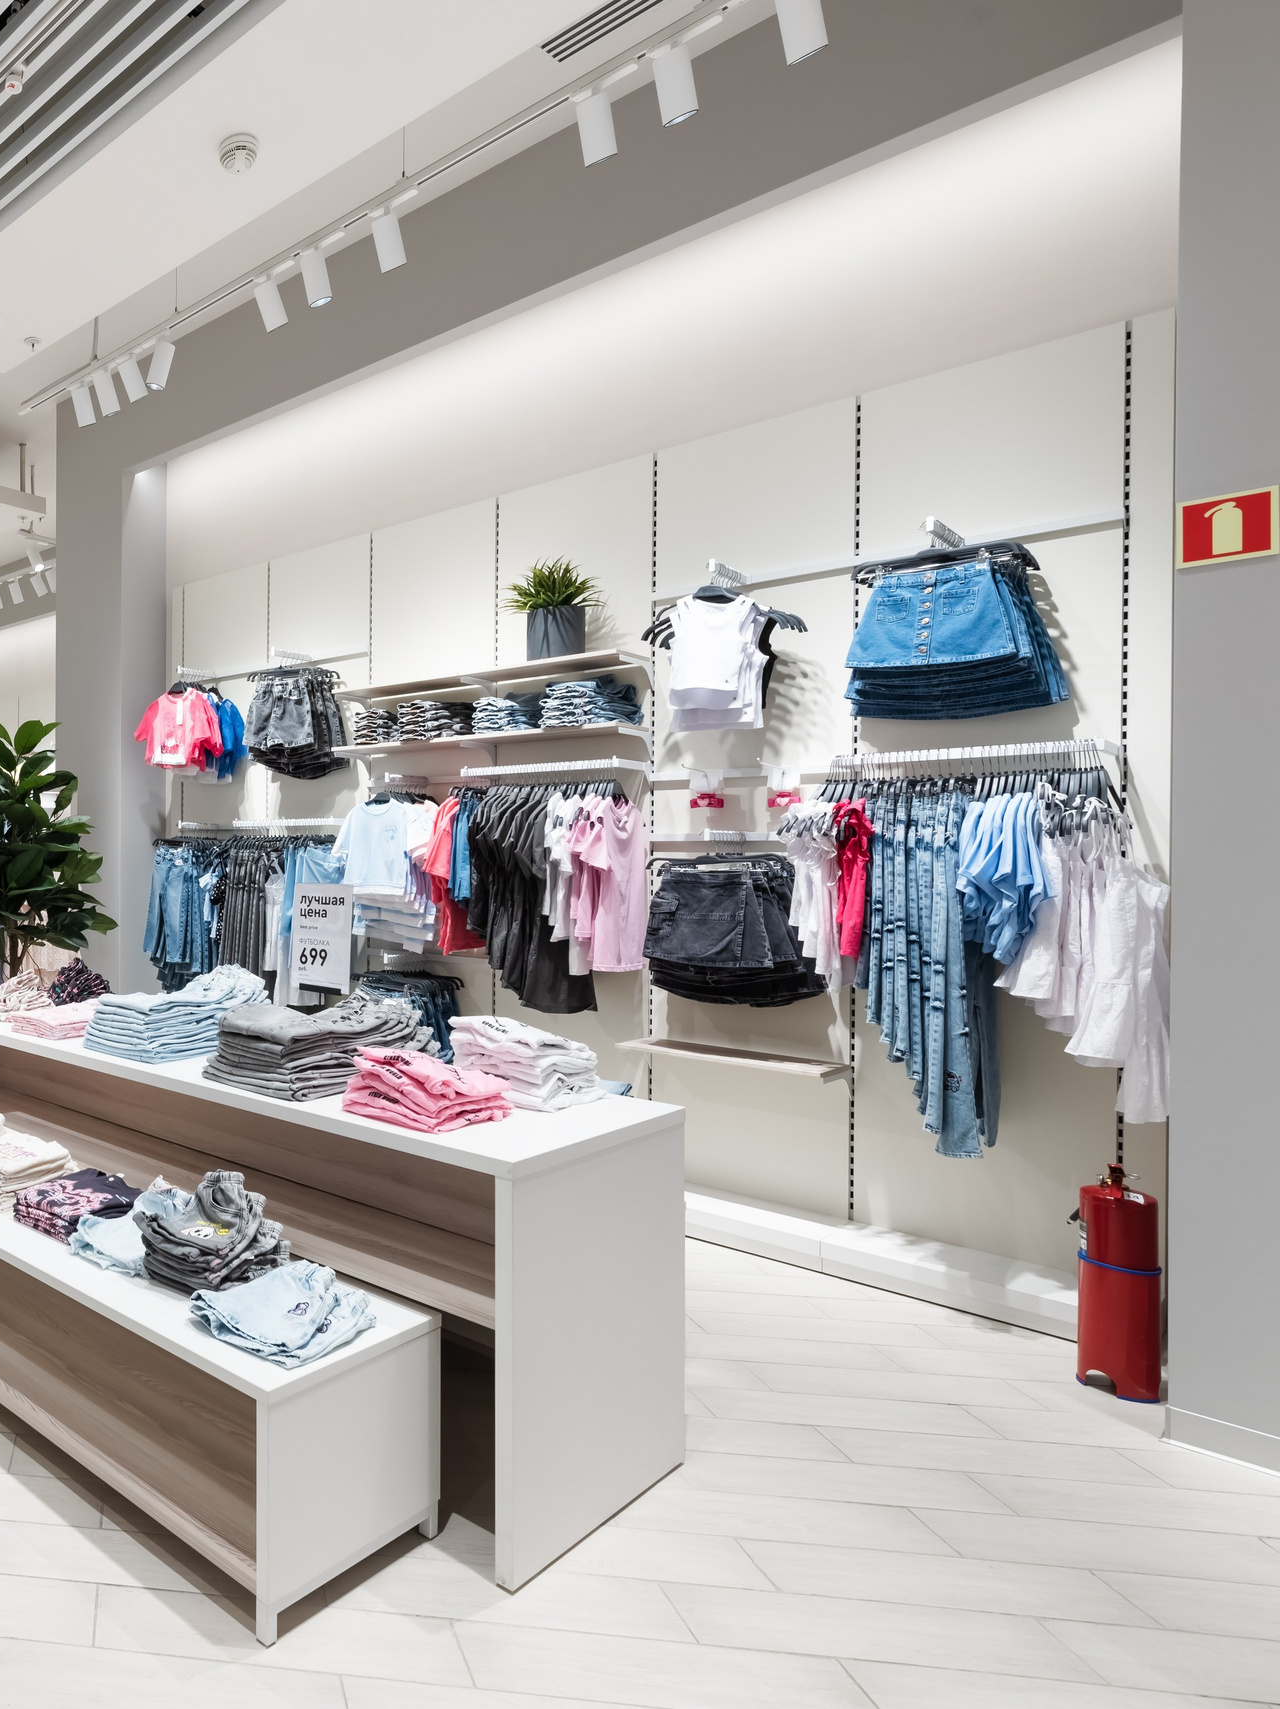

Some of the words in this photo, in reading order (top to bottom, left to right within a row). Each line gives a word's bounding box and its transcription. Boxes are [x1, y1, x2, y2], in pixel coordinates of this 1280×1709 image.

[300, 895, 345, 907] лучшая
[300, 908, 327, 919] цена
[299, 938, 330, 946] ФУТБОЛКА
[299, 947, 328, 967] 699
